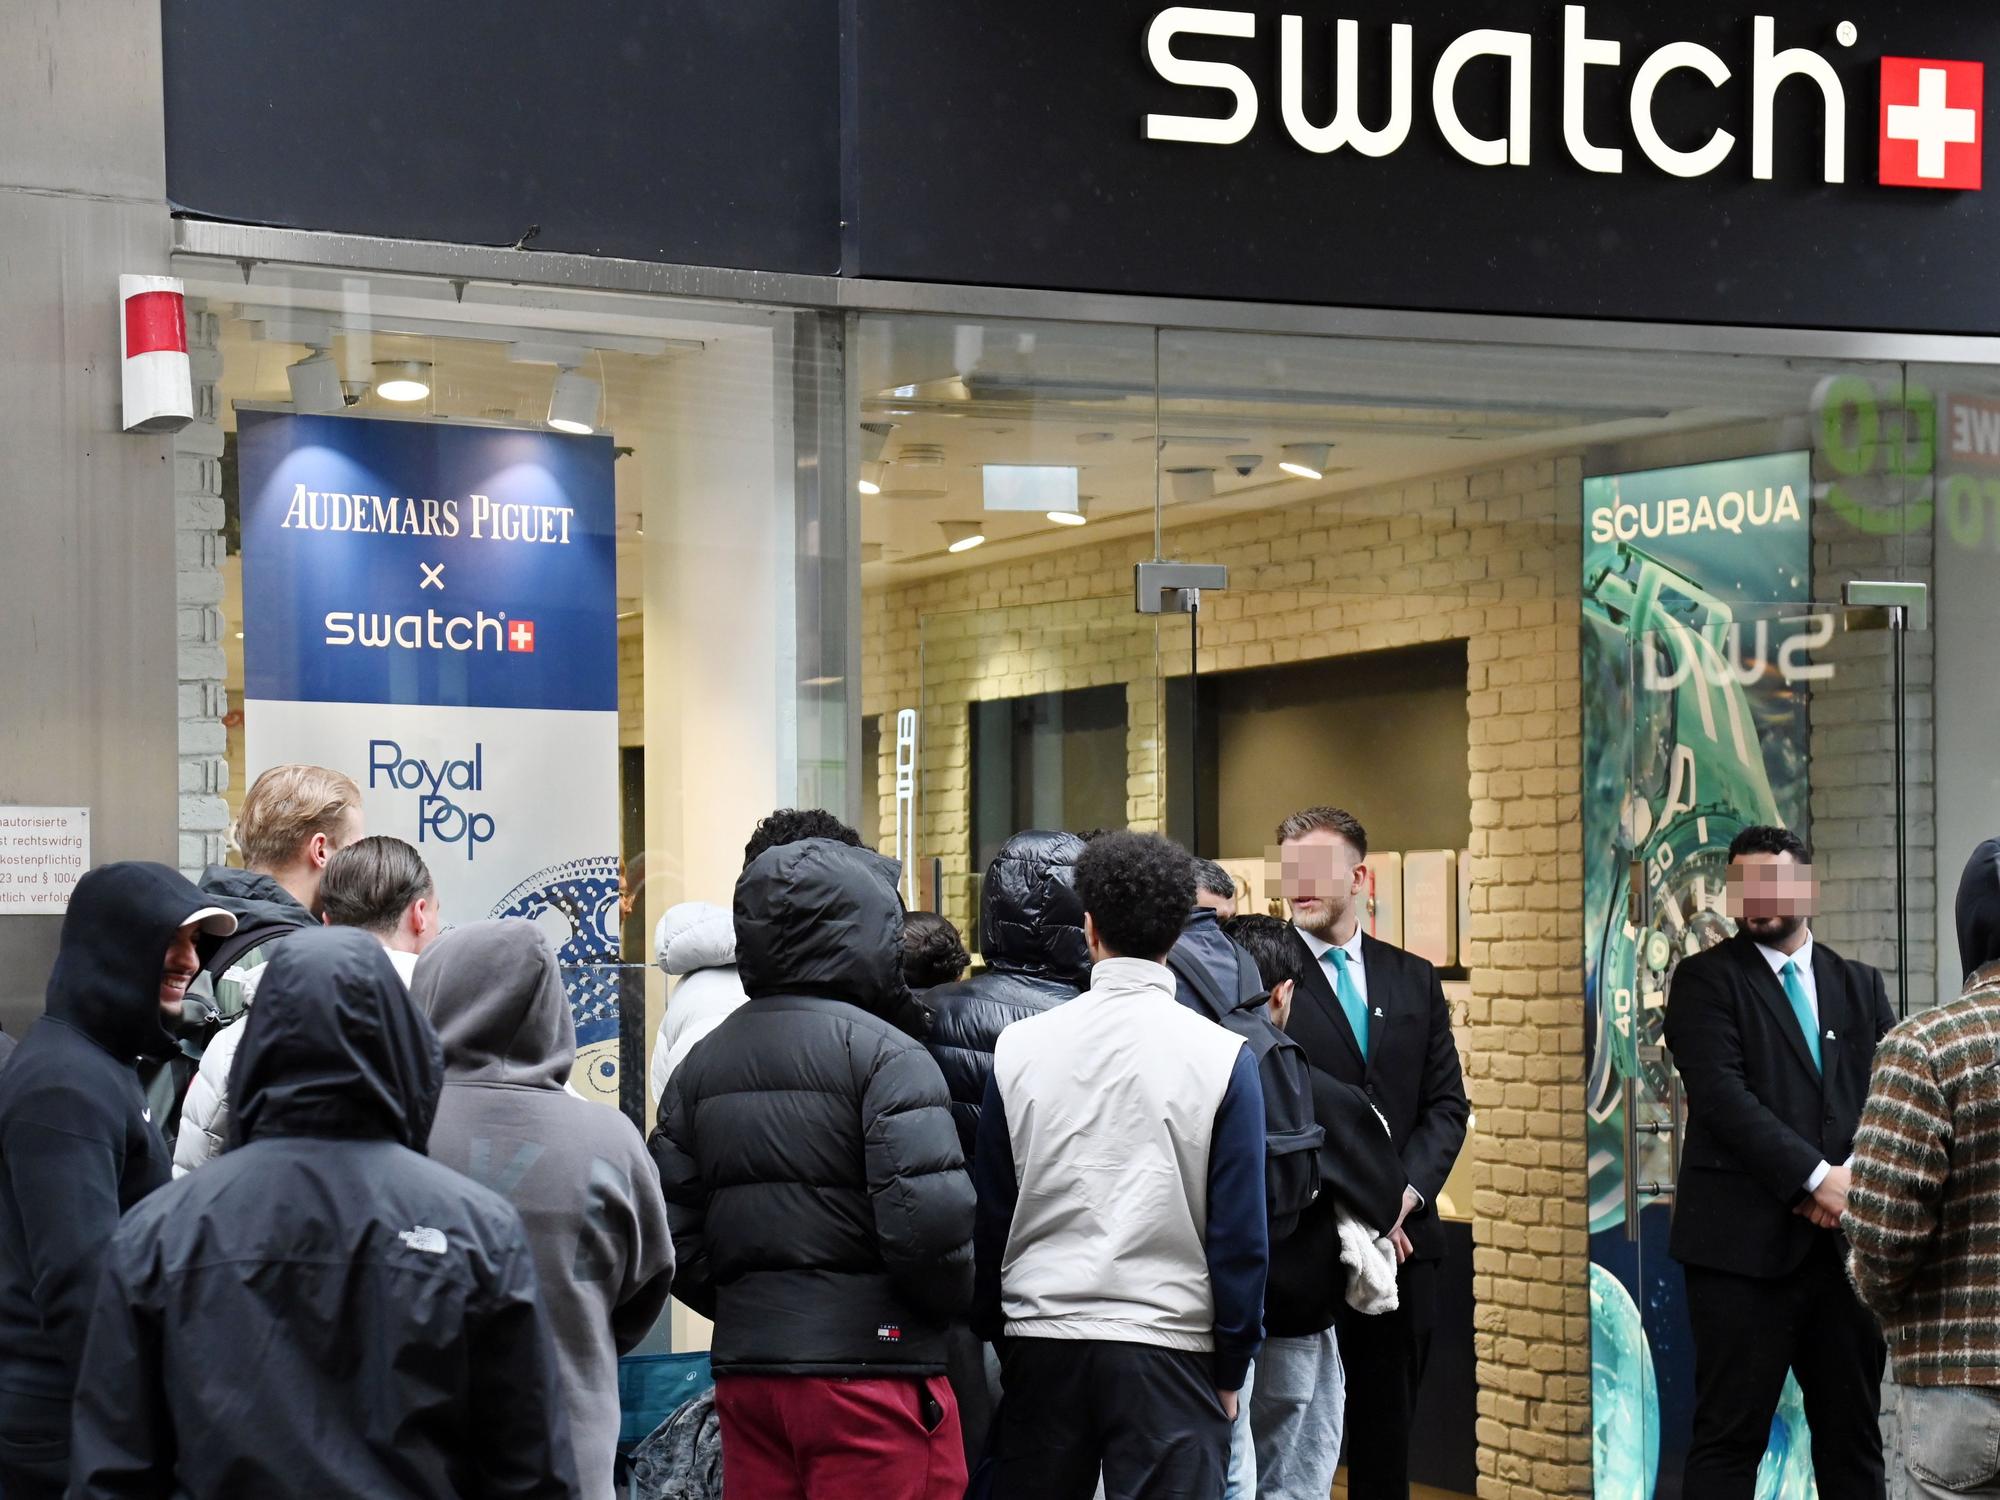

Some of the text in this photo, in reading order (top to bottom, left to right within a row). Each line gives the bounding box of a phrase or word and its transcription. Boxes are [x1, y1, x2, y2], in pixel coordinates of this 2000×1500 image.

[281, 483, 575, 545] AUDEMARS PIGUET
[1591, 484, 1801, 544] SCUBAQUA
[369, 739, 482, 806] Royal
[13, 835, 82, 849] rechtswidrig
[0, 854, 82, 868] kostenpflichtig
[17, 873, 38, 884] und
[42, 871, 49, 885] §
[54, 873, 77, 884] 1004
[0, 892, 26, 903] tlich
[1614, 988, 1632, 1038] 40
